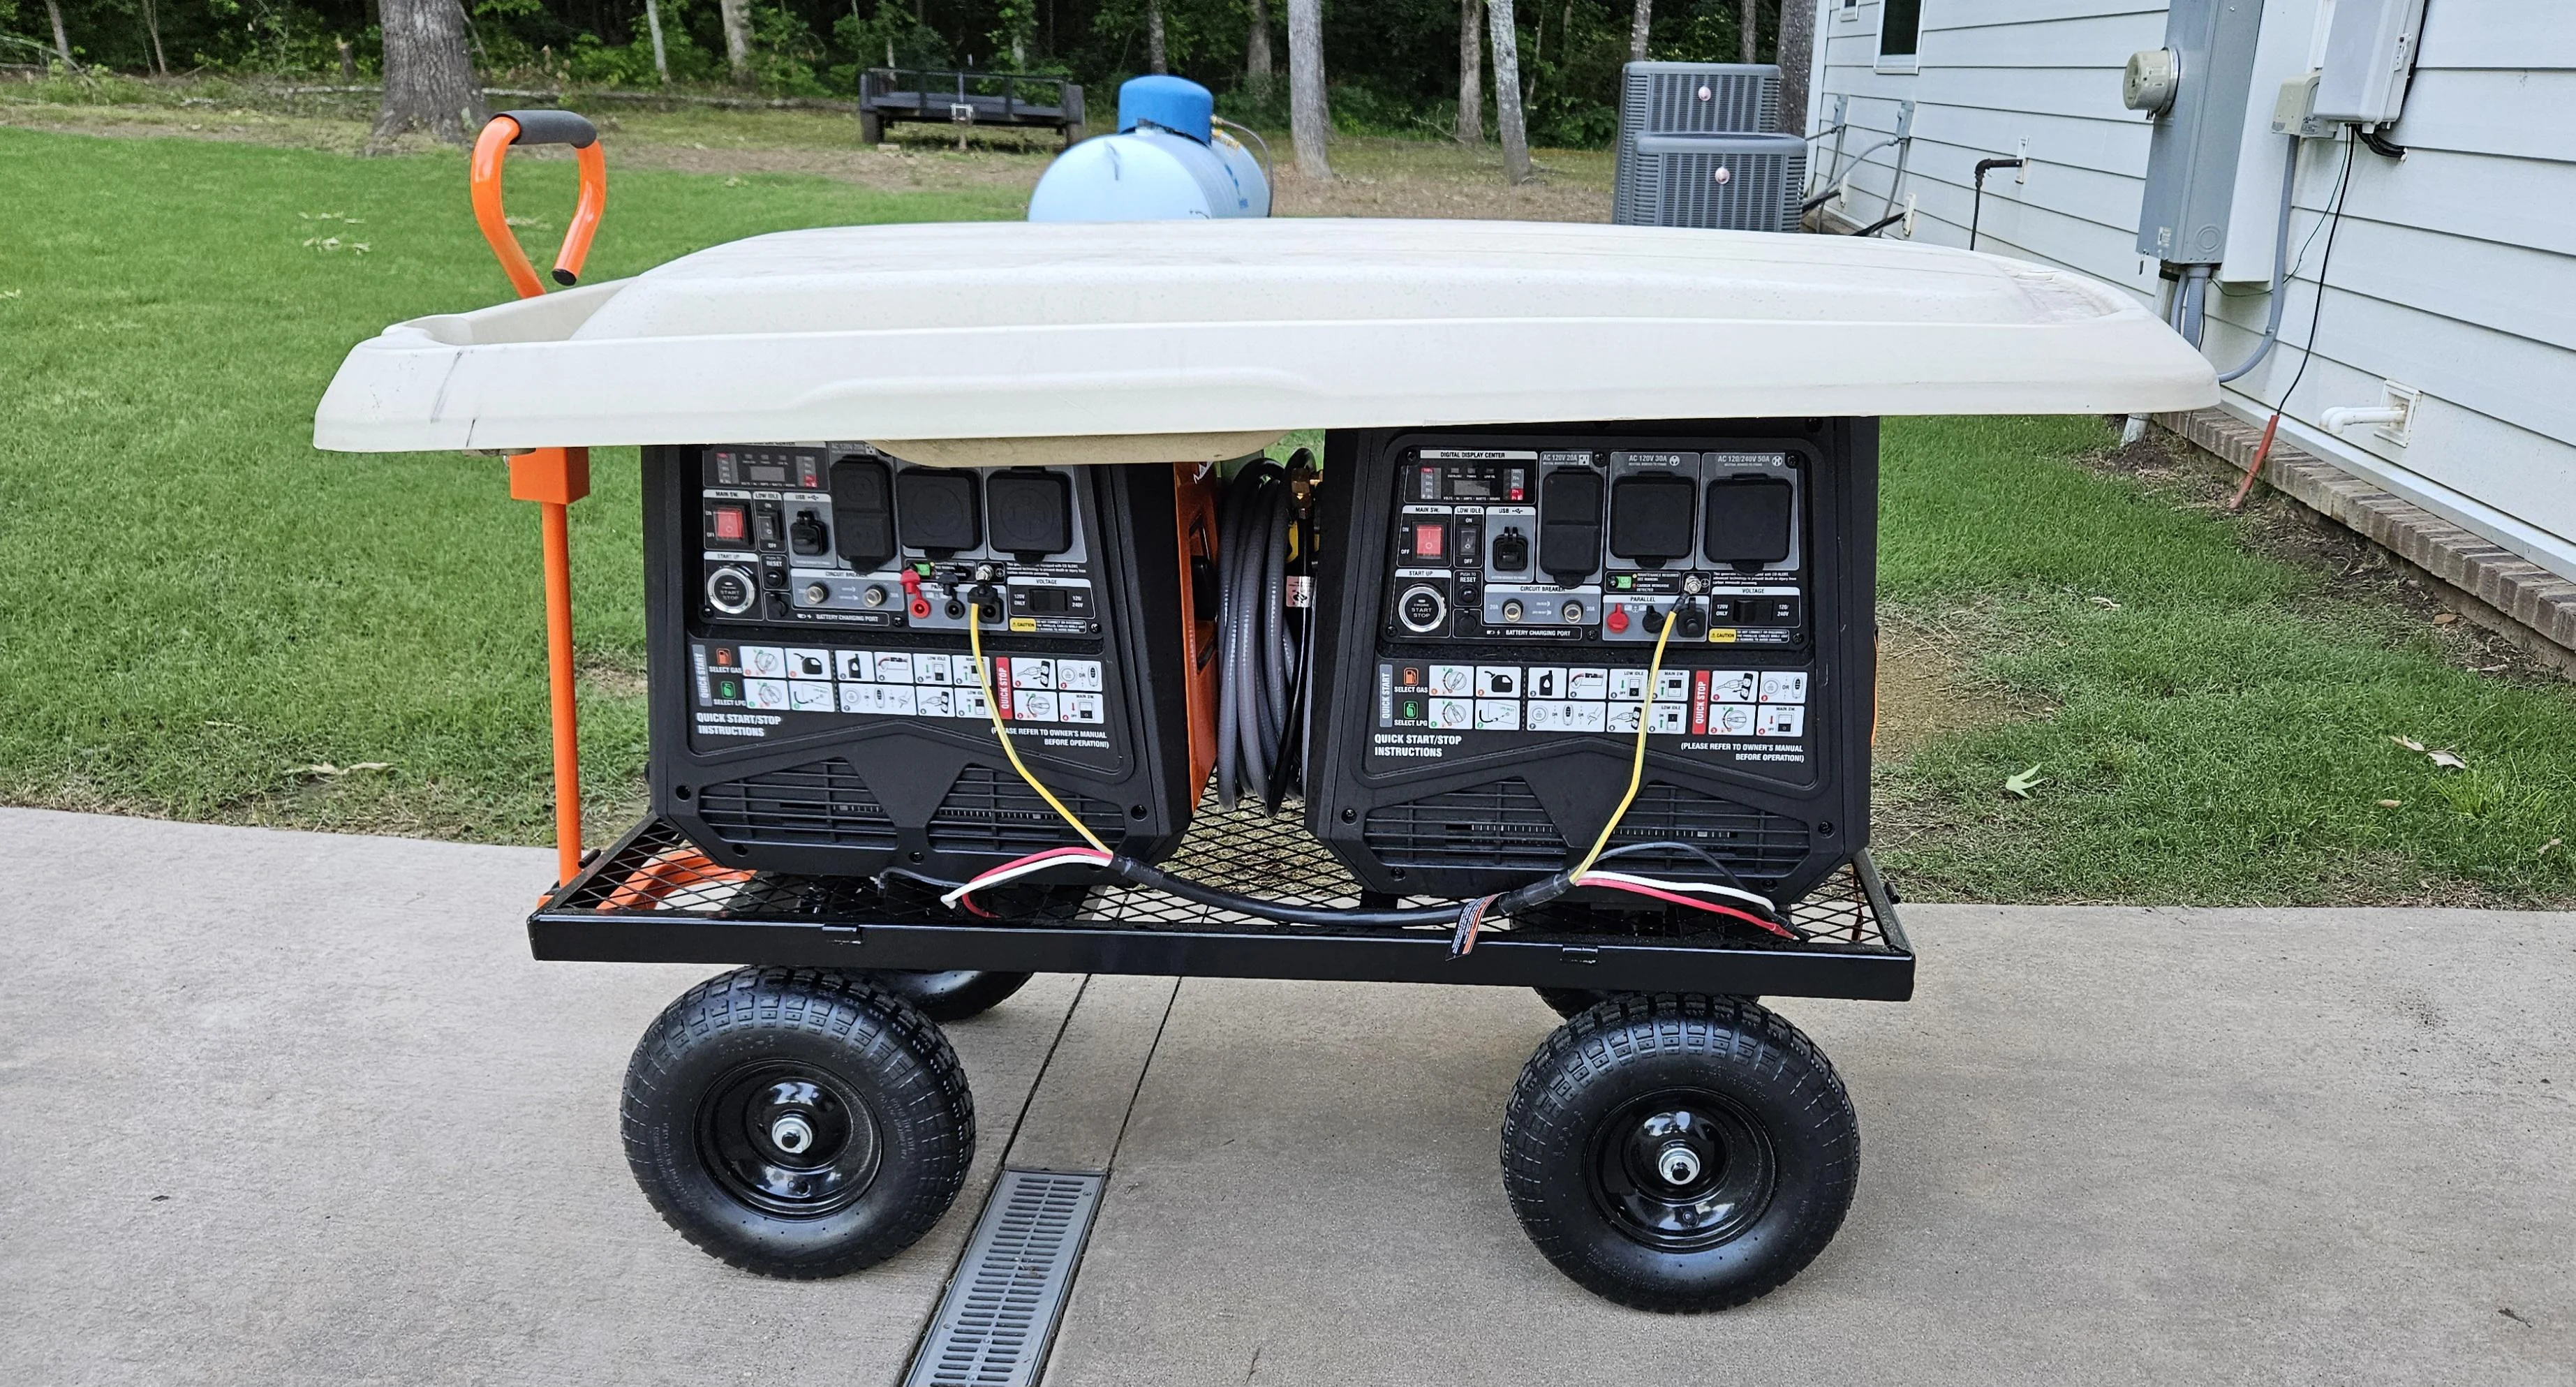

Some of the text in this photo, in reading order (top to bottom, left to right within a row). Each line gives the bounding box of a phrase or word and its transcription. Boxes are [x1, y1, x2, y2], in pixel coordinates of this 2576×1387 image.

[694, 653, 709, 698] QUICK START
[998, 667, 1009, 709] QUICK STOP
[1382, 673, 1391, 719] QUICK START
[1695, 681, 1706, 724] QUICK STOP
[697, 712, 782, 725] QUICK START/STOP
[698, 725, 765, 737] INSTRUCTIONS
[1374, 734, 1462, 746] QUICK START/STOP
[1375, 746, 1442, 757] INSTRUCTIONS
